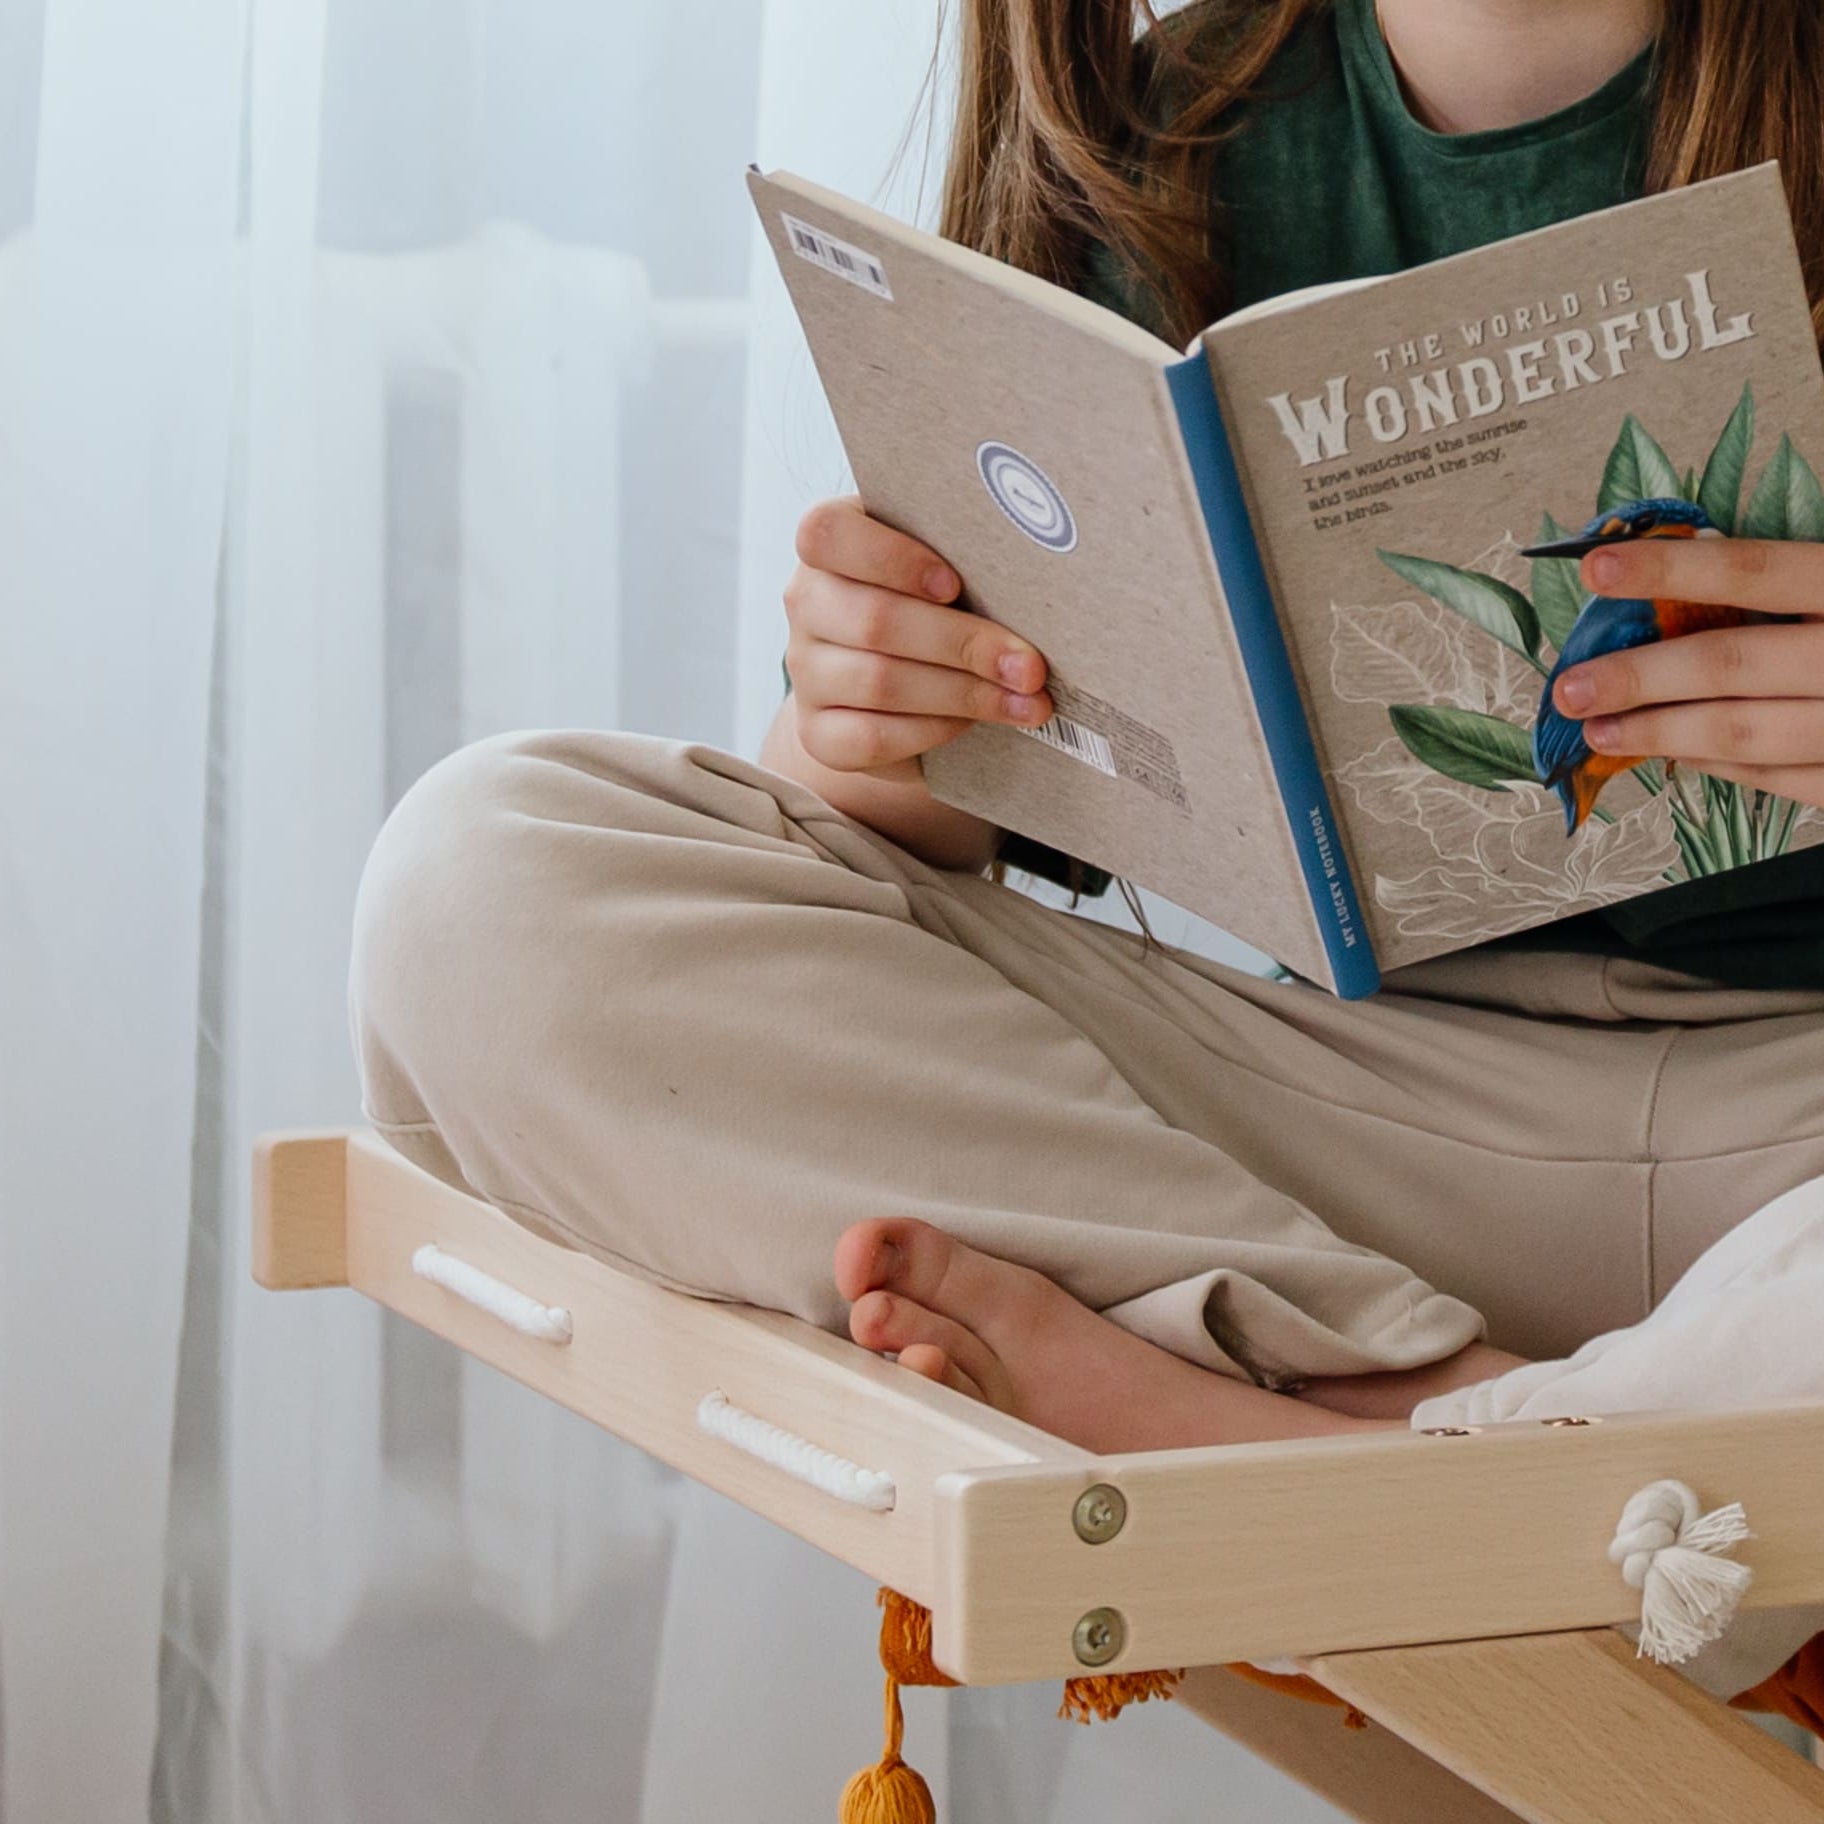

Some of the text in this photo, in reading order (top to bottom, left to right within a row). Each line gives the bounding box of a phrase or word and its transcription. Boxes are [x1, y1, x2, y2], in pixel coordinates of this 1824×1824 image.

[1375, 276, 1635, 373] THE WORLD IS
[1267, 268, 1758, 467] WONDERFUL
[1303, 419, 1528, 492] I love watching the sunrise
[1308, 493, 1341, 512] and
[1344, 477, 1400, 502] sunset
[1403, 466, 1436, 485] and
[1439, 457, 1468, 475] the
[1313, 500, 1393, 531] the birds.
[1310, 806, 1357, 948] MY LUCKY NOTEBOOK
